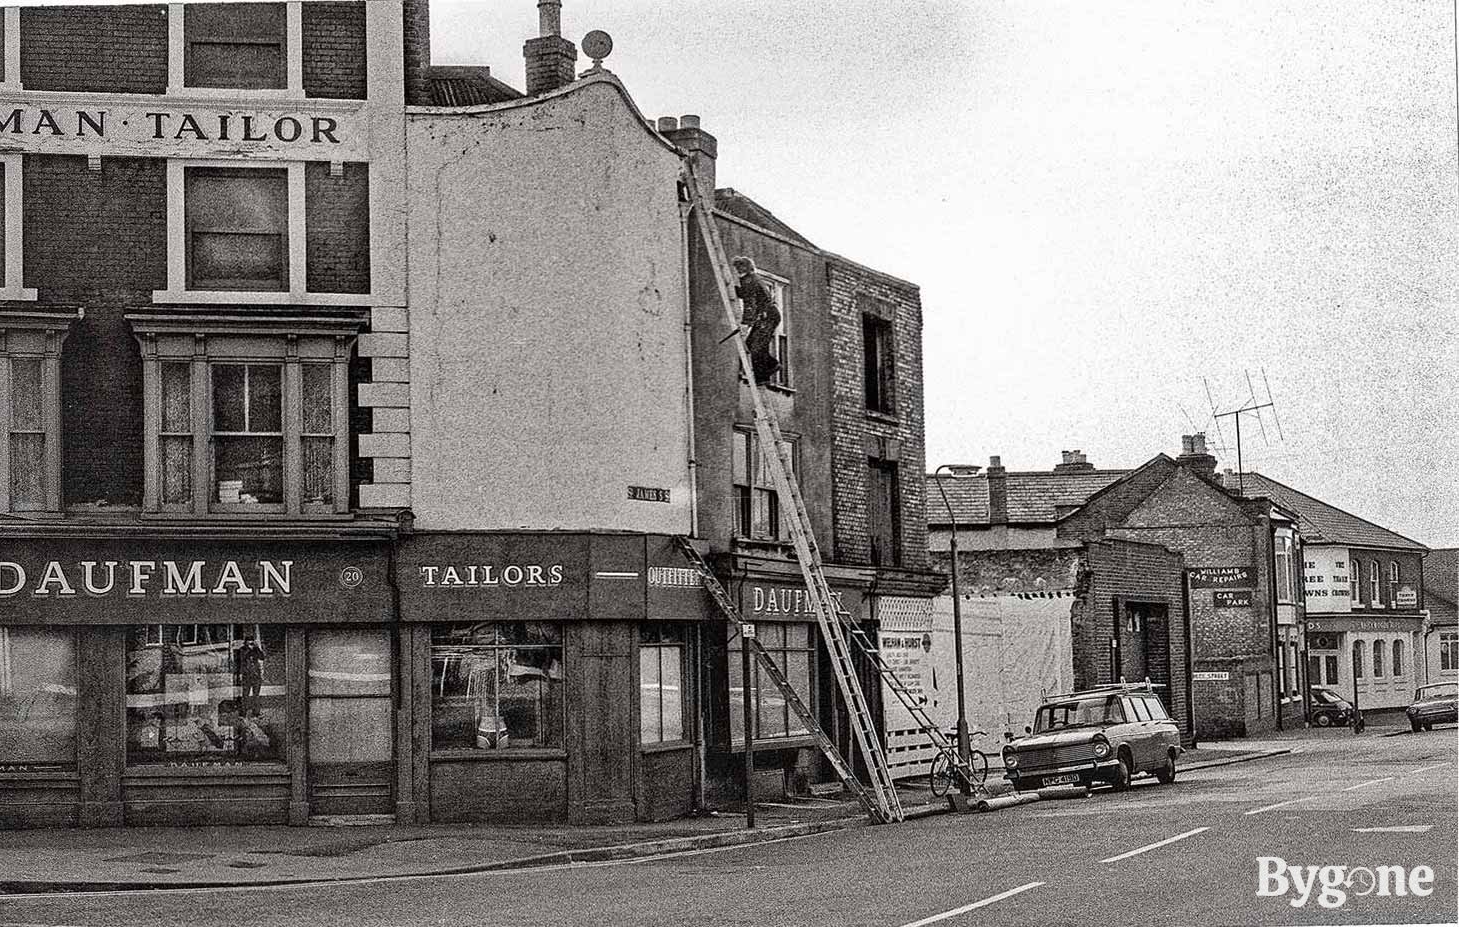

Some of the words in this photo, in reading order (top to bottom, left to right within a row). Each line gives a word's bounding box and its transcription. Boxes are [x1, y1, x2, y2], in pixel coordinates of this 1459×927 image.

[145, 111, 342, 146] TAILOR
[343, 571, 359, 582] 20
[419, 564, 564, 588] TAILORS
[1189, 571, 1207, 582] CAR
[1213, 571, 1248, 583] REPAIRS
[753, 586, 851, 614] DAUFMN
[1216, 592, 1234, 600] CAR
